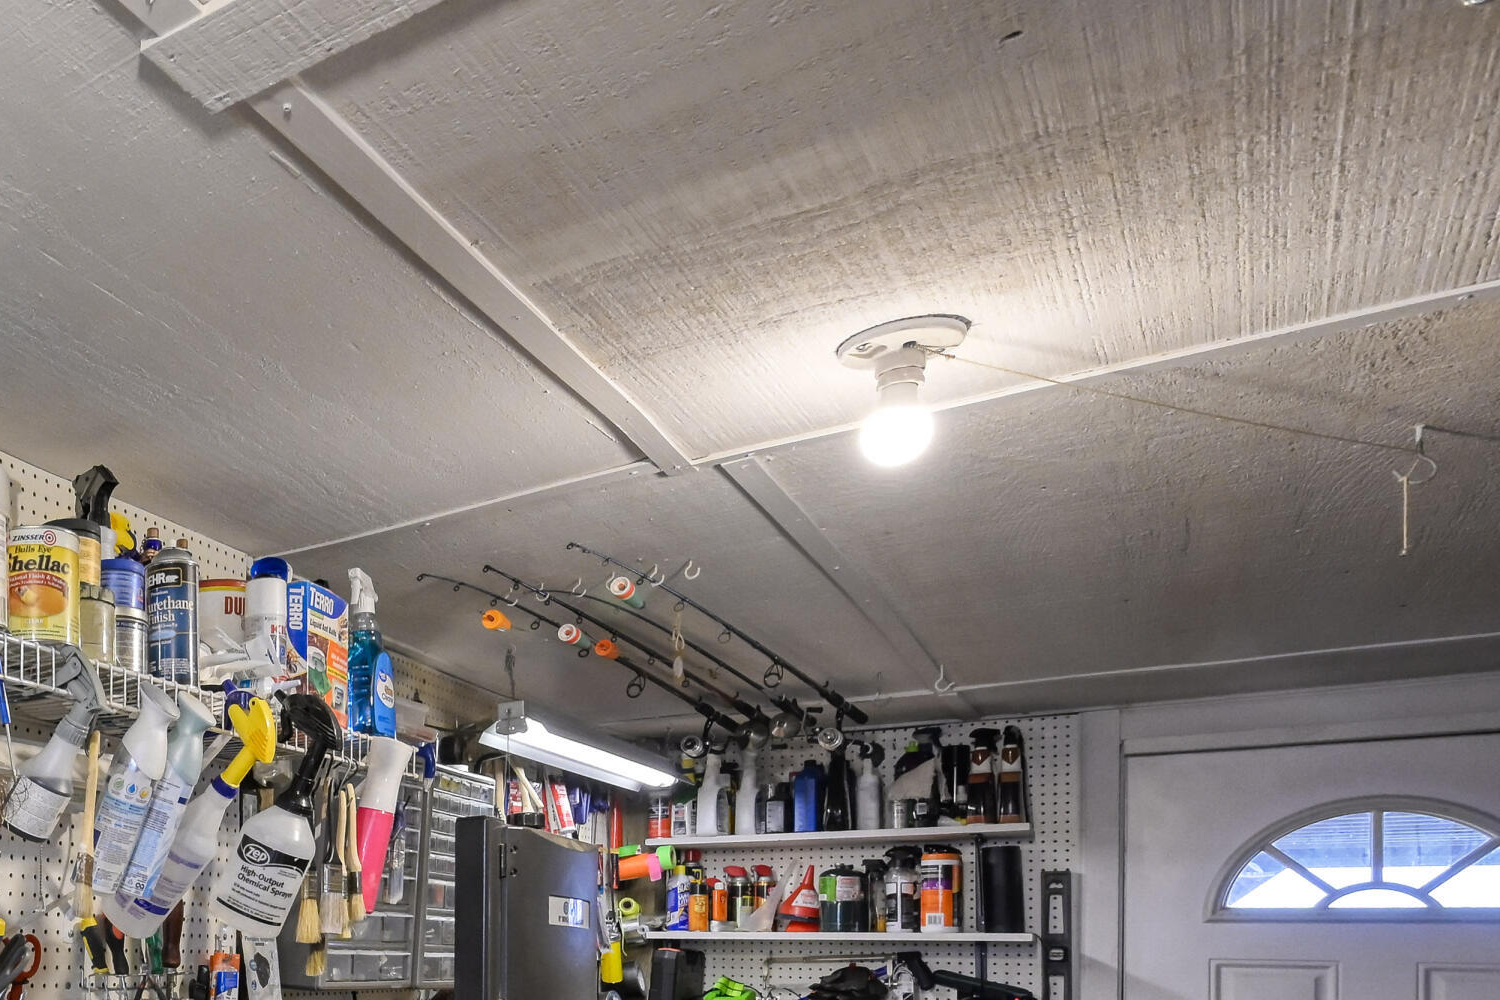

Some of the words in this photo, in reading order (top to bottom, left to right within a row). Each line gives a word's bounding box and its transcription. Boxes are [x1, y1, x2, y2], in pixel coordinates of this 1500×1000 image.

[12, 533, 45, 542] ZINSSER
[14, 544, 35, 554] Bulls
[289, 585, 305, 631] TERRO
[309, 586, 335, 617] TERRO
[246, 846, 267, 862] Zep
[237, 873, 270, 893] Chemical
[240, 865, 284, 888] High-Output
